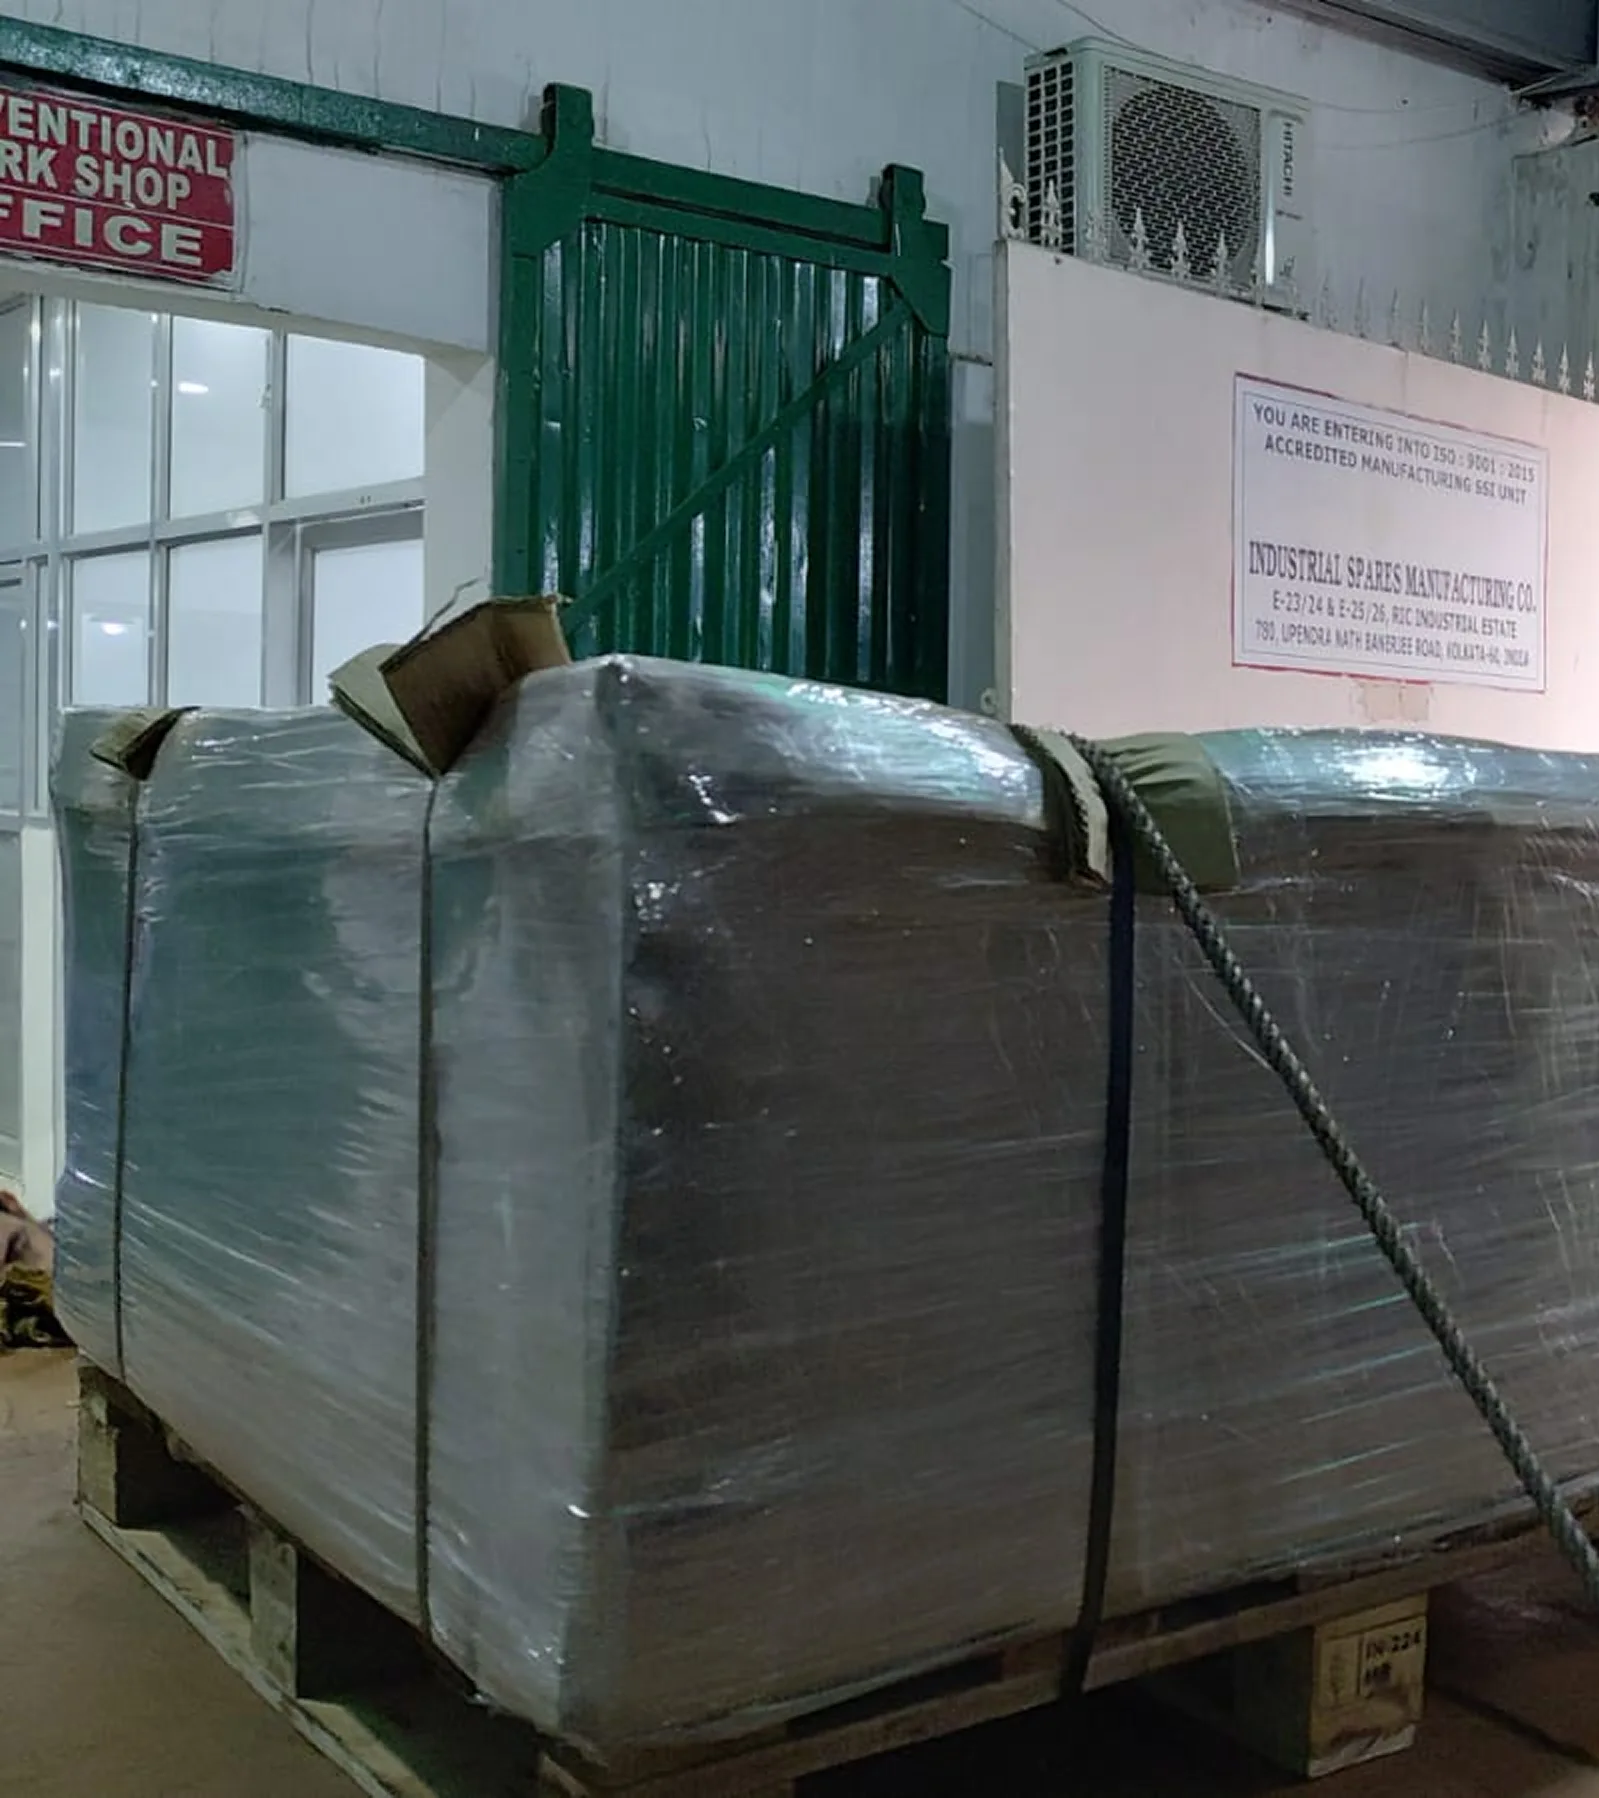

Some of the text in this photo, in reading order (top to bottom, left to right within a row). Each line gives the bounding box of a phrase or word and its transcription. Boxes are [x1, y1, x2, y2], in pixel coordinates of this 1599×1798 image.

[0, 94, 229, 179] ENTIONAL
[1283, 122, 1294, 196] HITACHI
[73, 154, 191, 210] SHOP
[1254, 402, 1286, 427] YOU
[1291, 412, 1320, 434] ARE
[1324, 419, 1394, 451] ENTERING
[1397, 435, 1431, 460] INTO
[1433, 444, 1456, 466] ISO
[1466, 452, 1496, 475] 9001
[1507, 462, 1536, 483] 2015
[1264, 433, 1528, 505] ACCREDITED MANUFACTURING SSI UNIT
[1249, 540, 1538, 614] INDUSTRIAL SPARES MANUFACTURING CO.
[1272, 589, 1323, 616] E-23/24
[1415, 607, 1479, 635] INDUSTRIAL
[1481, 615, 1519, 640] ESTATE
